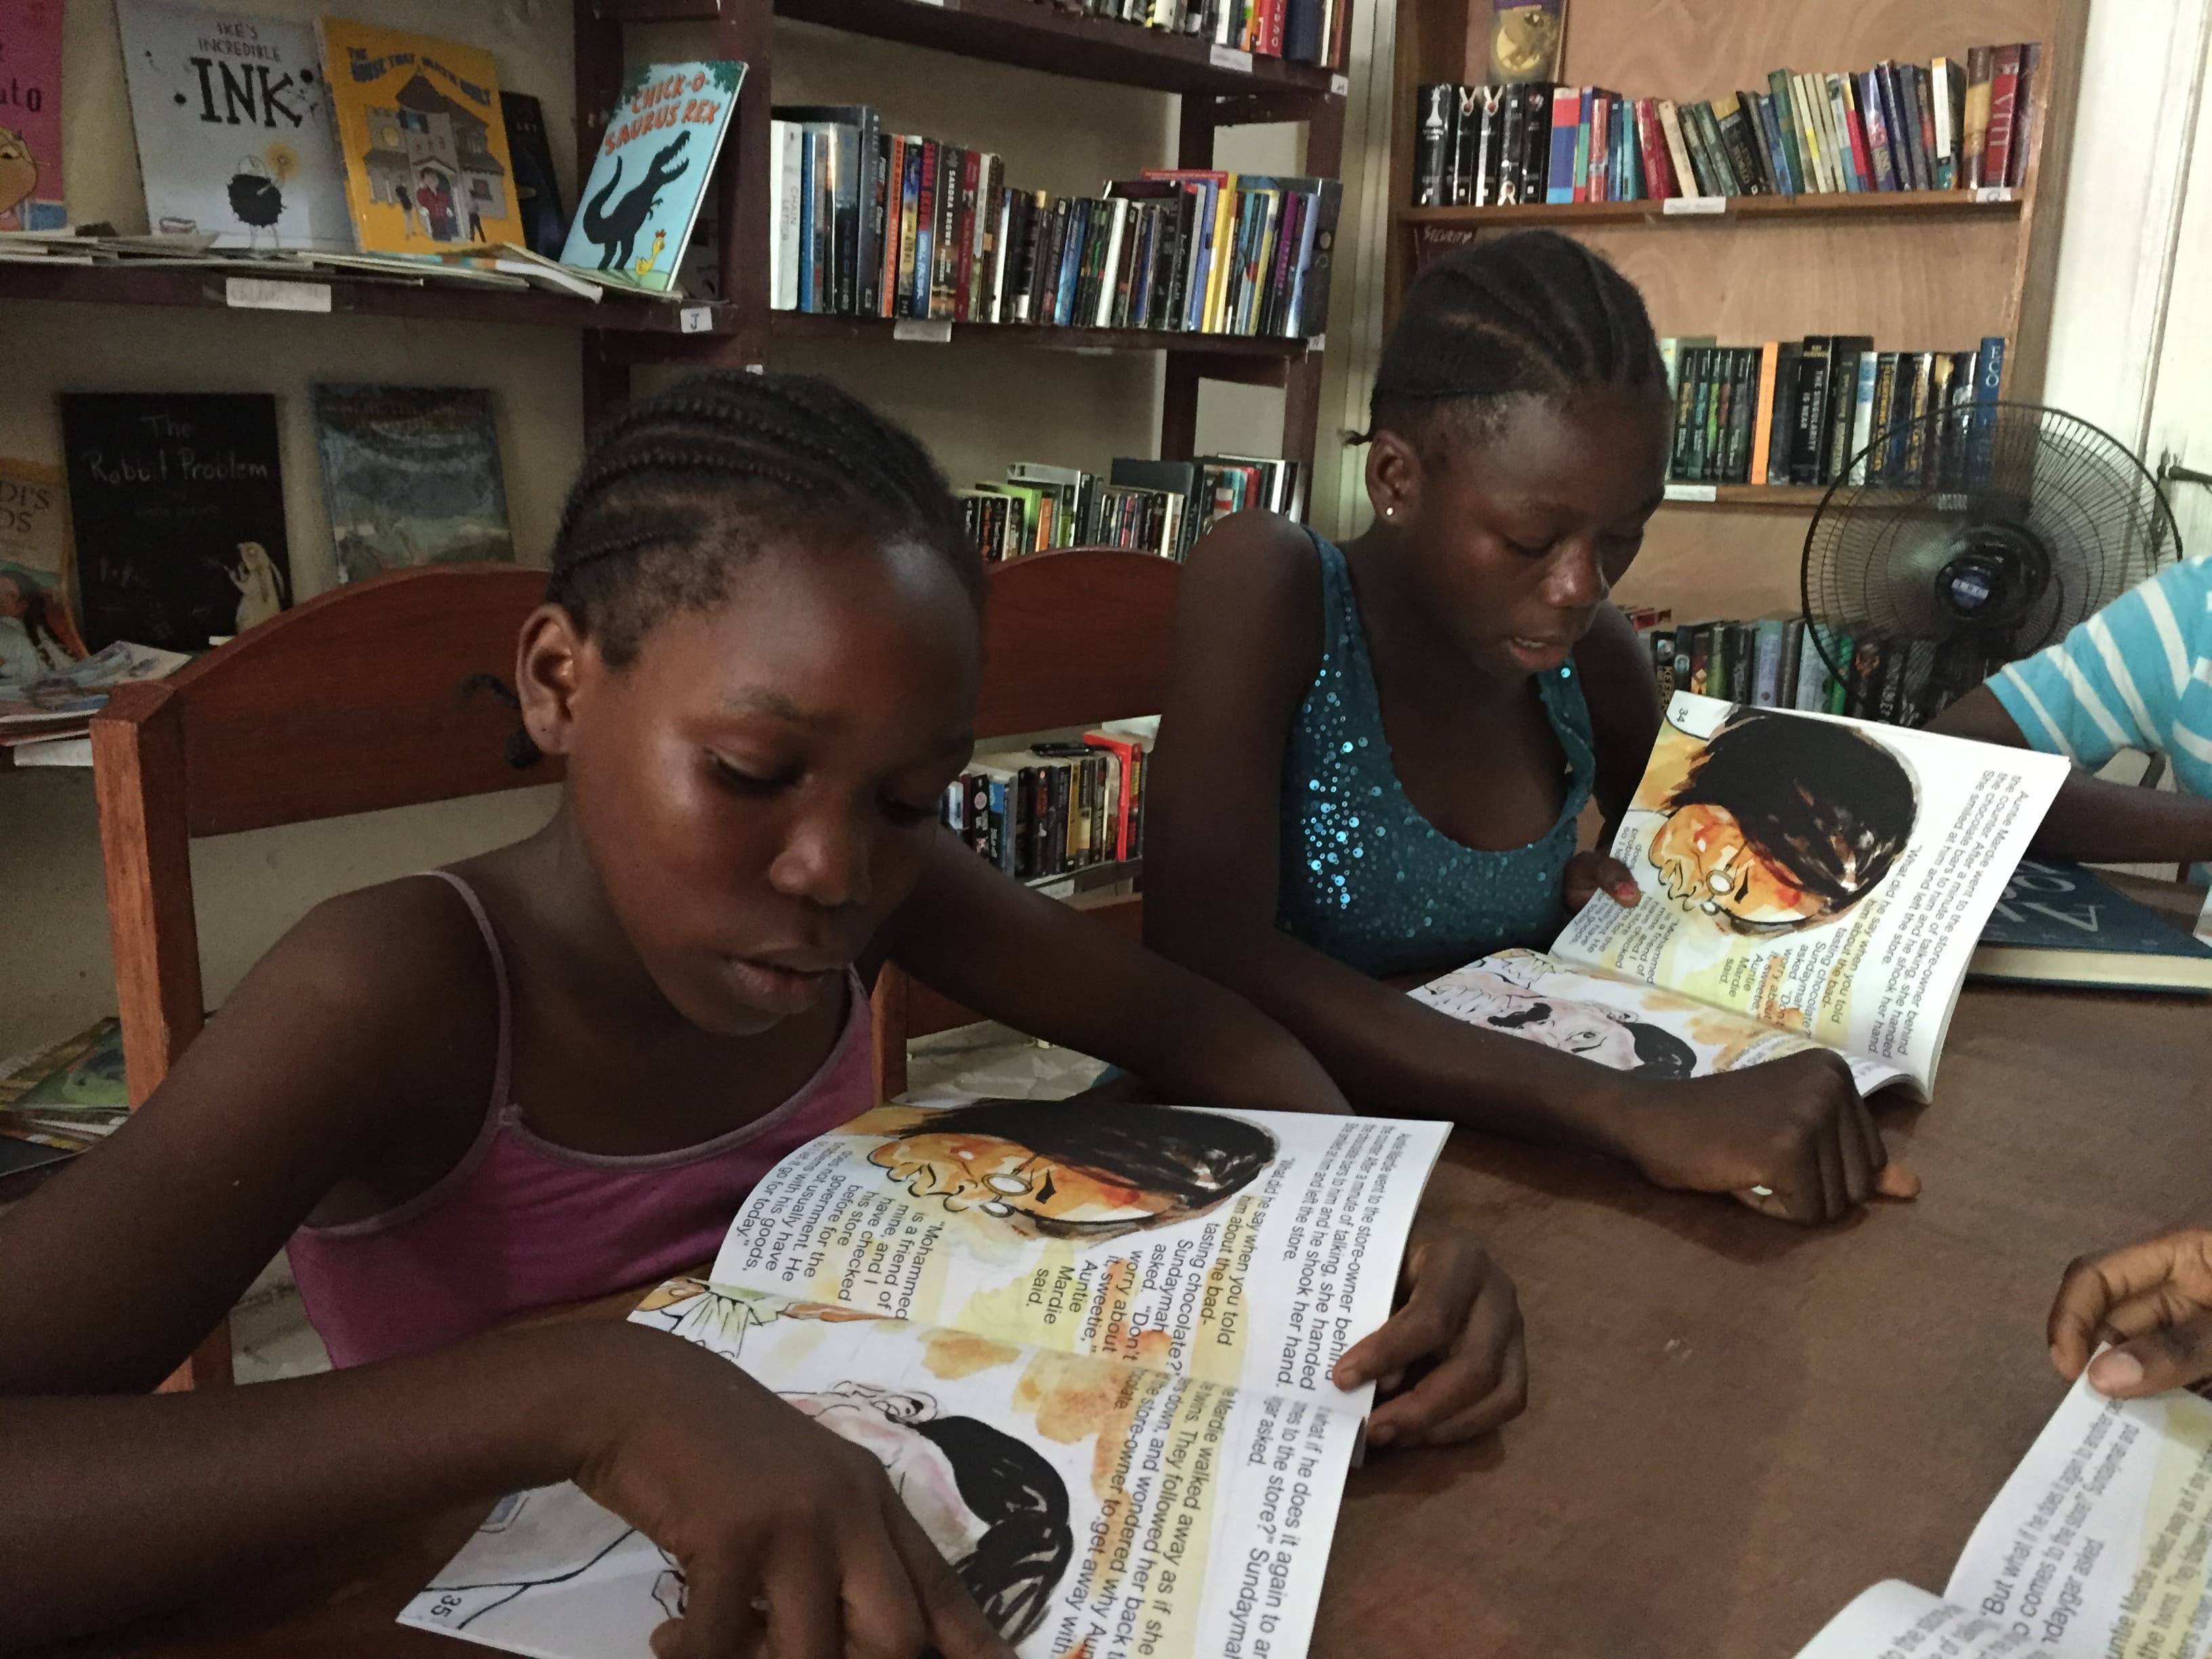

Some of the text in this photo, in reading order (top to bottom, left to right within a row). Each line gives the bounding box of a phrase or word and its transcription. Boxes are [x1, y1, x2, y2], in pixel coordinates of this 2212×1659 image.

[198, 38, 281, 62] INCREDIBLE
[217, 22, 258, 40] IKE'S
[190, 57, 304, 128] INK
[605, 98, 721, 157] SAURUS REX
[944, 170, 956, 246] SANDRA BROWN
[140, 413, 192, 438] The
[178, 446, 268, 483] Problem
[1675, 708, 1689, 723] 34
[1937, 878, 1950, 888] to
[1956, 900, 1968, 911] to
[1864, 917, 1880, 938] say
[1877, 900, 1891, 914] he
[1899, 913, 1914, 930] the
[1911, 914, 1927, 937] and
[1928, 922, 1938, 936] of
[1944, 914, 1961, 933] the
[1841, 922, 1862, 956] about
[1849, 941, 1869, 971] when
[1902, 939, 1917, 954] he
[1830, 958, 1847, 977] the
[1839, 973, 1853, 996] you
[1885, 957, 1906, 994] shook
[1912, 935, 1948, 1008] store-owner
[1831, 1000, 1846, 1024] told
[1877, 996, 1892, 1019] her
[1896, 984, 1910, 1006] she
[1882, 1010, 1903, 1059] handed
[1898, 1010, 1919, 1056] behind
[764, 1181, 783, 1195] for
[771, 1197, 793, 1214] his
[766, 1168, 833, 1271] not usually have
[782, 1175, 846, 1282] government. He
[804, 1185, 863, 1277] before for the
[837, 1191, 880, 1246] his store
[880, 1204, 909, 1237] mine,
[1283, 1206, 1313, 1261] the store.
[1361, 1207, 1379, 1223] the
[743, 1218, 775, 1271] goods,
[838, 1198, 895, 1301] have checked
[867, 1243, 888, 1274] and
[877, 1212, 925, 1311] is a friend of
[1189, 1223, 1221, 1269] tasting
[892, 1221, 945, 1322] "Mohammed
[1026, 1269, 1049, 1306] said.
[1069, 1260, 1098, 1312] Auntie
[1141, 1244, 1166, 1292] asked.
[1149, 1240, 1193, 1334] Sundaymah
[1200, 1216, 1243, 1326] about the bad-
[1216, 1211, 1266, 1346] say when you told
[1339, 1226, 1371, 1313] store-owner
[1044, 1266, 1075, 1324] Mardie
[1102, 1251, 1143, 1353] worry about
[1276, 1207, 1332, 1387] and he shook her hand.
[1300, 1214, 1354, 1391] of talking, she handed
[1247, 1419, 1274, 1466] asked.
[1273, 1446, 1295, 1471] the
[1052, 1398, 1155, 1654] store-owner to get away with
[1090, 1438, 1164, 1618] and wondered why
[1258, 1475, 1284, 1544] store?"
[1112, 1431, 1198, 1645] They followed her back
[1138, 1448, 1213, 1656] walked away as if she
[1259, 1457, 1319, 1633] he does it again to
[430, 1594, 462, 1618] 35
[2019, 1561, 2056, 1618] comes
